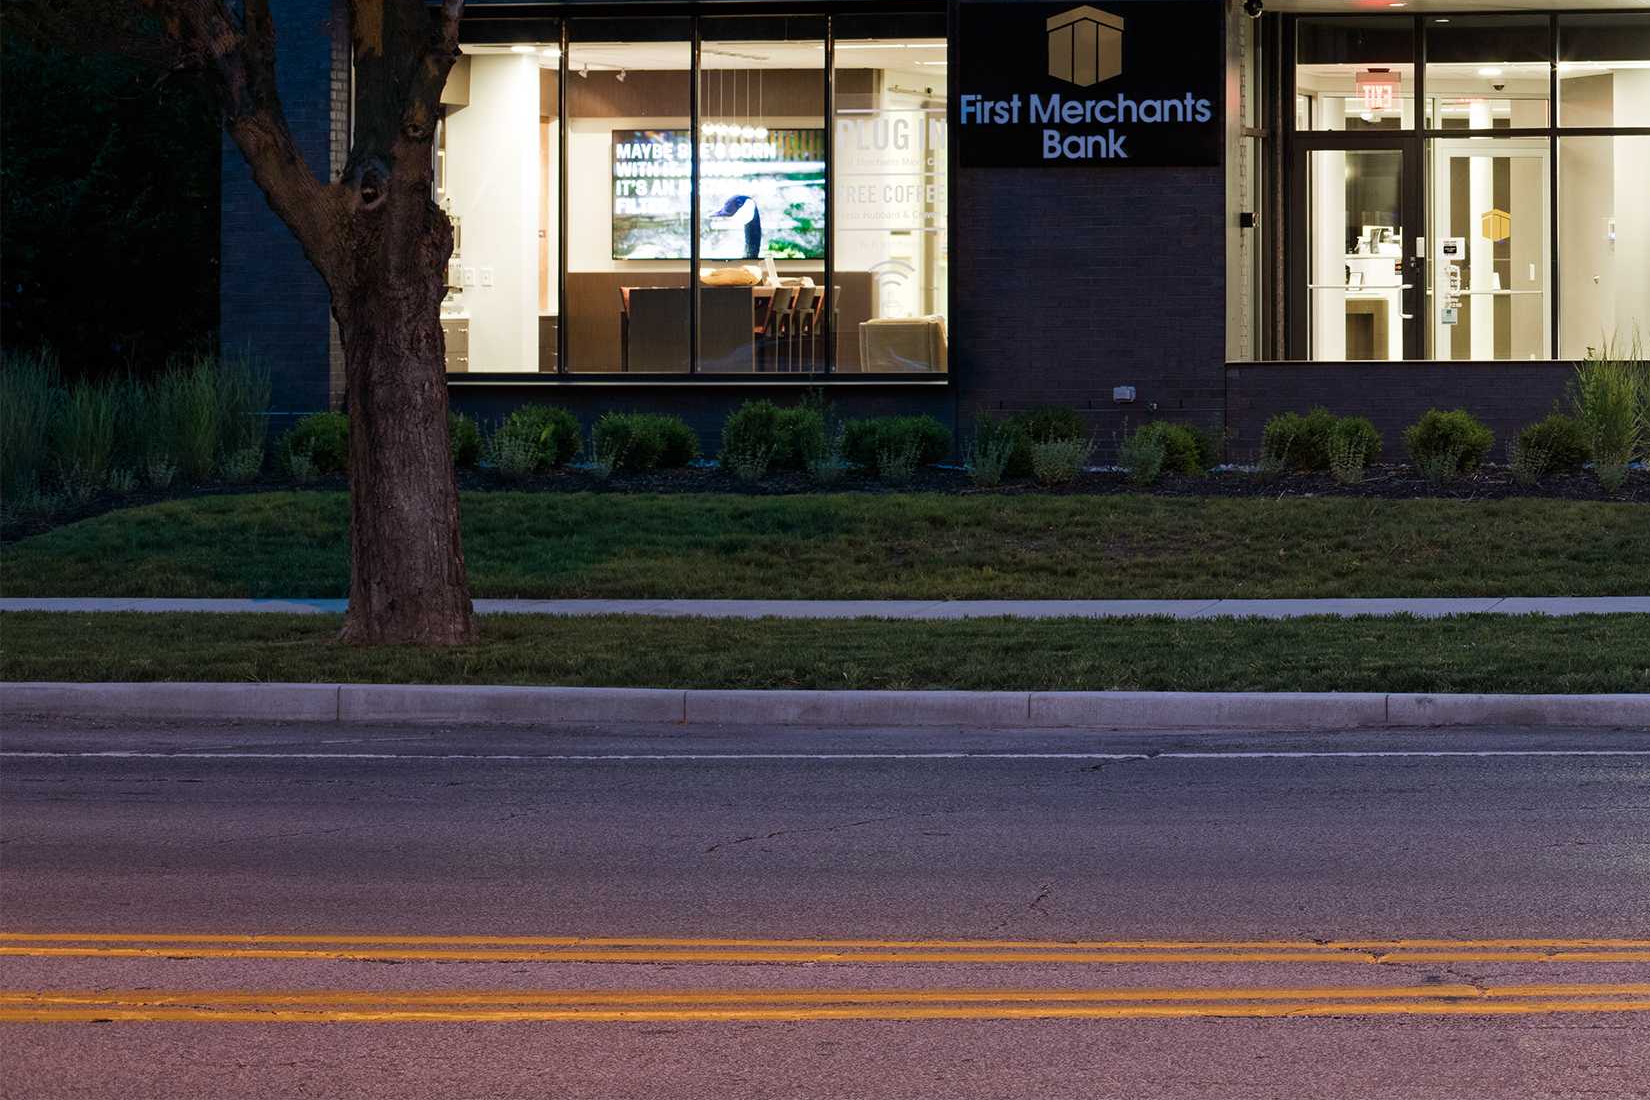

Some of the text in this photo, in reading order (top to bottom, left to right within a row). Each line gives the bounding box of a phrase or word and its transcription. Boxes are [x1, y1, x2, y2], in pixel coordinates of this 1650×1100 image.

[960, 92, 1212, 125] First Merchants
[837, 118, 909, 151] PLUG
[1042, 129, 1129, 160] Bank
[616, 143, 674, 159] MAYBE
[616, 180, 649, 196] IT'S
[837, 184, 946, 204] FREE COFFEE
